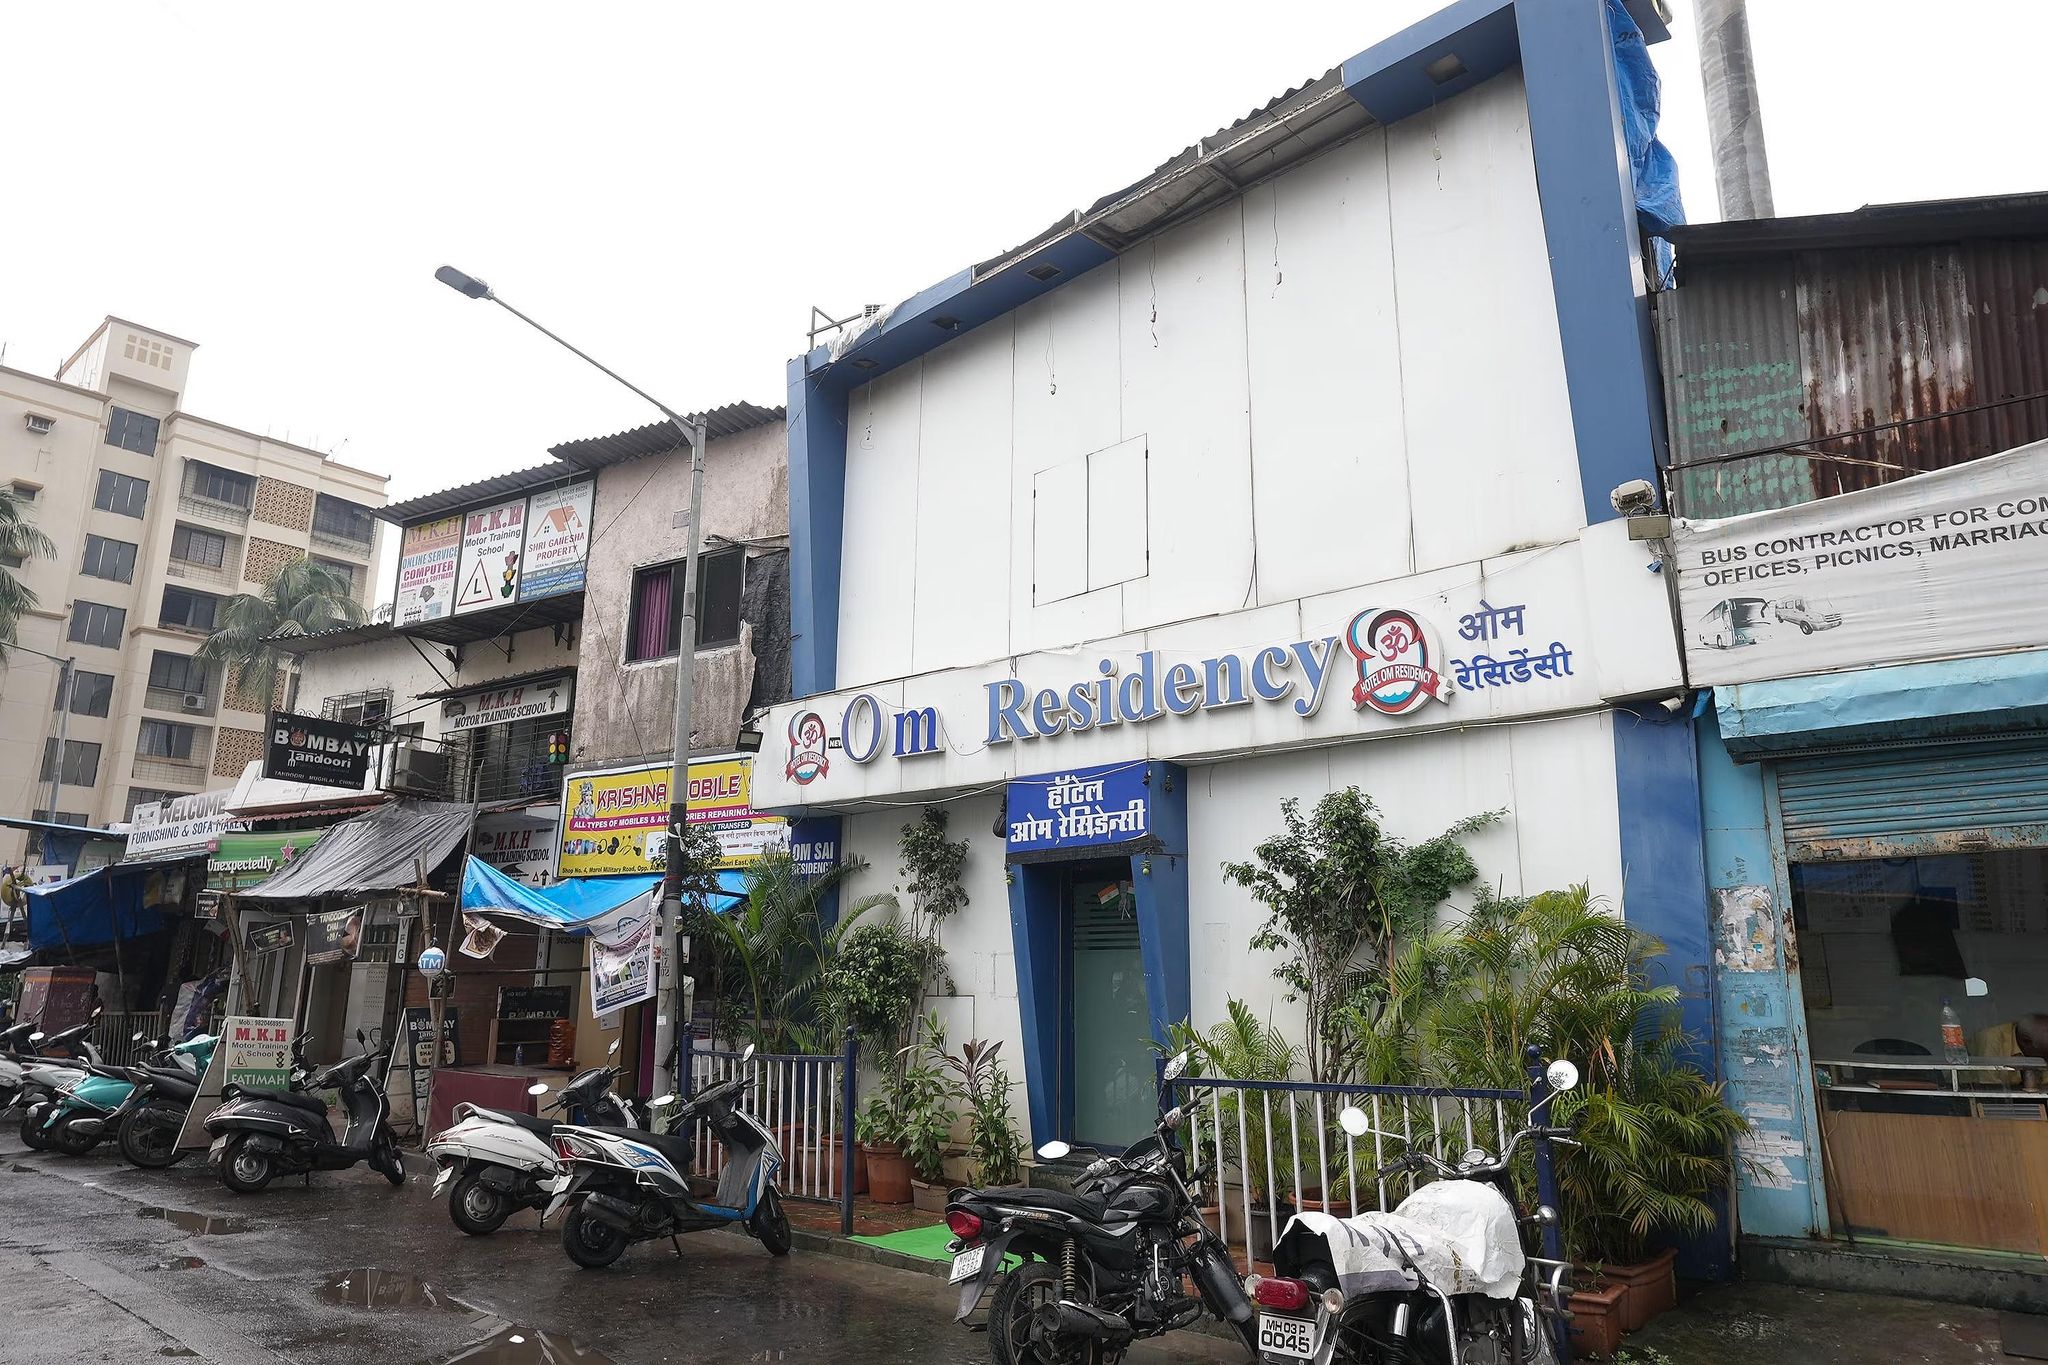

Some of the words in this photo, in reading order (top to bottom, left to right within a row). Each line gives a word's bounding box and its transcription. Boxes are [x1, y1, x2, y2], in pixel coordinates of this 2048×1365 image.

[466, 504, 524, 536] M.K.H
[408, 516, 459, 545] M.K.H
[464, 537, 487, 548] Motor
[489, 529, 521, 543] Training
[1701, 545, 1748, 566] BUS
[1754, 517, 1926, 558] CONTRACTOR
[1933, 507, 1990, 529] FOR
[477, 543, 505, 557] School
[528, 541, 547, 553] SHRI
[548, 532, 585, 548] GANESHA
[536, 544, 578, 561] PROPERTY
[402, 553, 428, 570] ONLINE
[403, 560, 454, 582] COMPUTER
[1703, 557, 1808, 587] OFFICES,
[1815, 541, 1922, 570] PICNICS,
[1458, 599, 1526, 641] ओम
[1450, 642, 1575, 691] रेसिडेंसी
[1360, 674, 1382, 695] HOTEL
[1381, 667, 1395, 681] OM
[1394, 665, 1433, 684] RESIDENCY
[477, 687, 525, 712] M.K.H
[841, 692, 942, 764] Om
[983, 635, 1340, 744] Residency
[454, 712, 481, 728] MOTOR
[480, 707, 519, 724] TRAINING
[518, 701, 548, 718] SCHOOL
[274, 728, 367, 757] BOMBAY
[288, 749, 351, 768] Tandoori
[274, 769, 305, 780] TANDOORI
[597, 783, 668, 812] KRISHNA
[686, 773, 741, 801] OBILE
[159, 793, 227, 825] WELCOME
[587, 820, 608, 828] TYPES
[608, 819, 618, 827] OF
[619, 816, 649, 826] MOBILES
[657, 812, 706, 823] ACORIES
[707, 808, 748, 819] REPAIRING
[131, 826, 179, 845] FURNISHING
[181, 825, 190, 837] &
[192, 820, 216, 836] SOFA
[694, 823, 717, 831] MOY
[717, 821, 750, 831] TRANSFER
[1010, 812, 1054, 843] ओम
[493, 830, 532, 850] M.K.H
[499, 849, 526, 863] TRAINING
[526, 847, 550, 861] SCHOOL
[792, 843, 811, 861] OM
[814, 841, 834, 860] SAI
[207, 856, 274, 873] Unexpectedly
[603, 865, 621, 873] Military
[637, 865, 649, 873] Opp.
[235, 1027, 287, 1042] M.K.H
[409, 1019, 456, 1031] BOMAY
[257, 1042, 289, 1051] Training
[237, 1056, 244, 1065] L
[231, 1074, 286, 1086] FATIMAH
[1266, 1319, 1283, 1332] MH
[1284, 1322, 1297, 1334] 03
[1298, 1324, 1306, 1335] P
[1261, 1330, 1310, 1353] 0045
